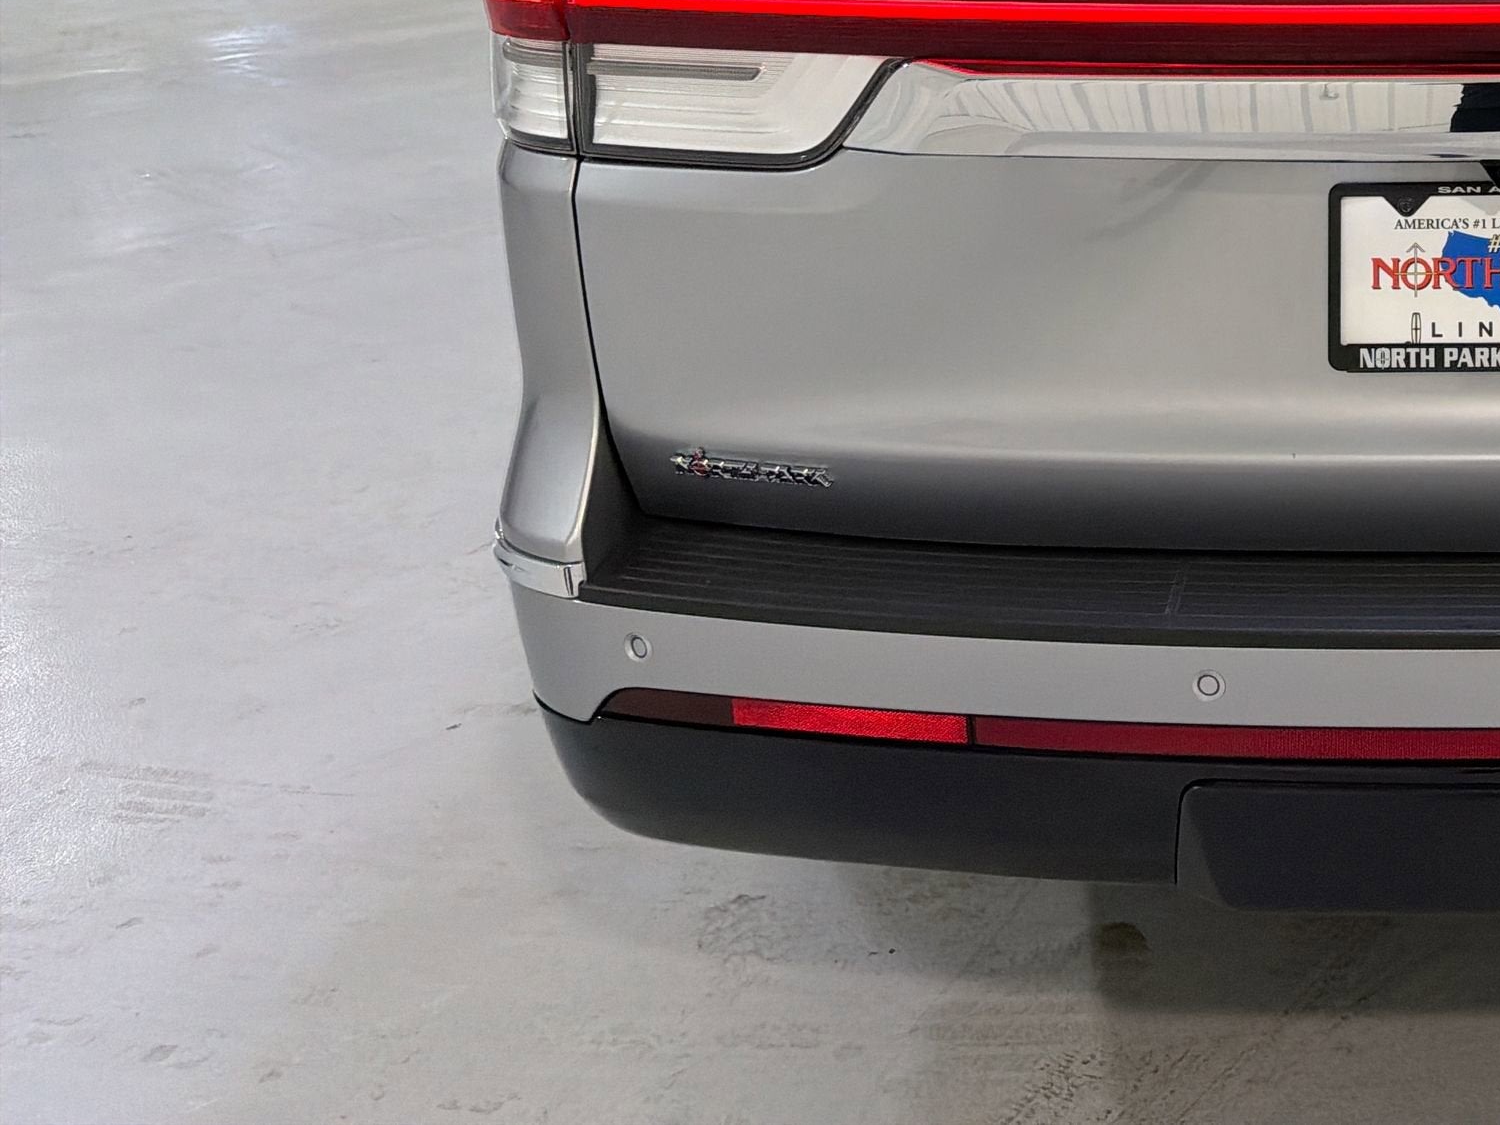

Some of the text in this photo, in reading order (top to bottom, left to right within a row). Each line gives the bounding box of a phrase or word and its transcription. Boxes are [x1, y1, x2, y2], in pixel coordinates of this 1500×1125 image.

[1437, 186, 1482, 194] SAN
[1394, 218, 1469, 230] AMERICA'S
[1473, 219, 1487, 229] #1
[1359, 347, 1436, 369] NORTH
